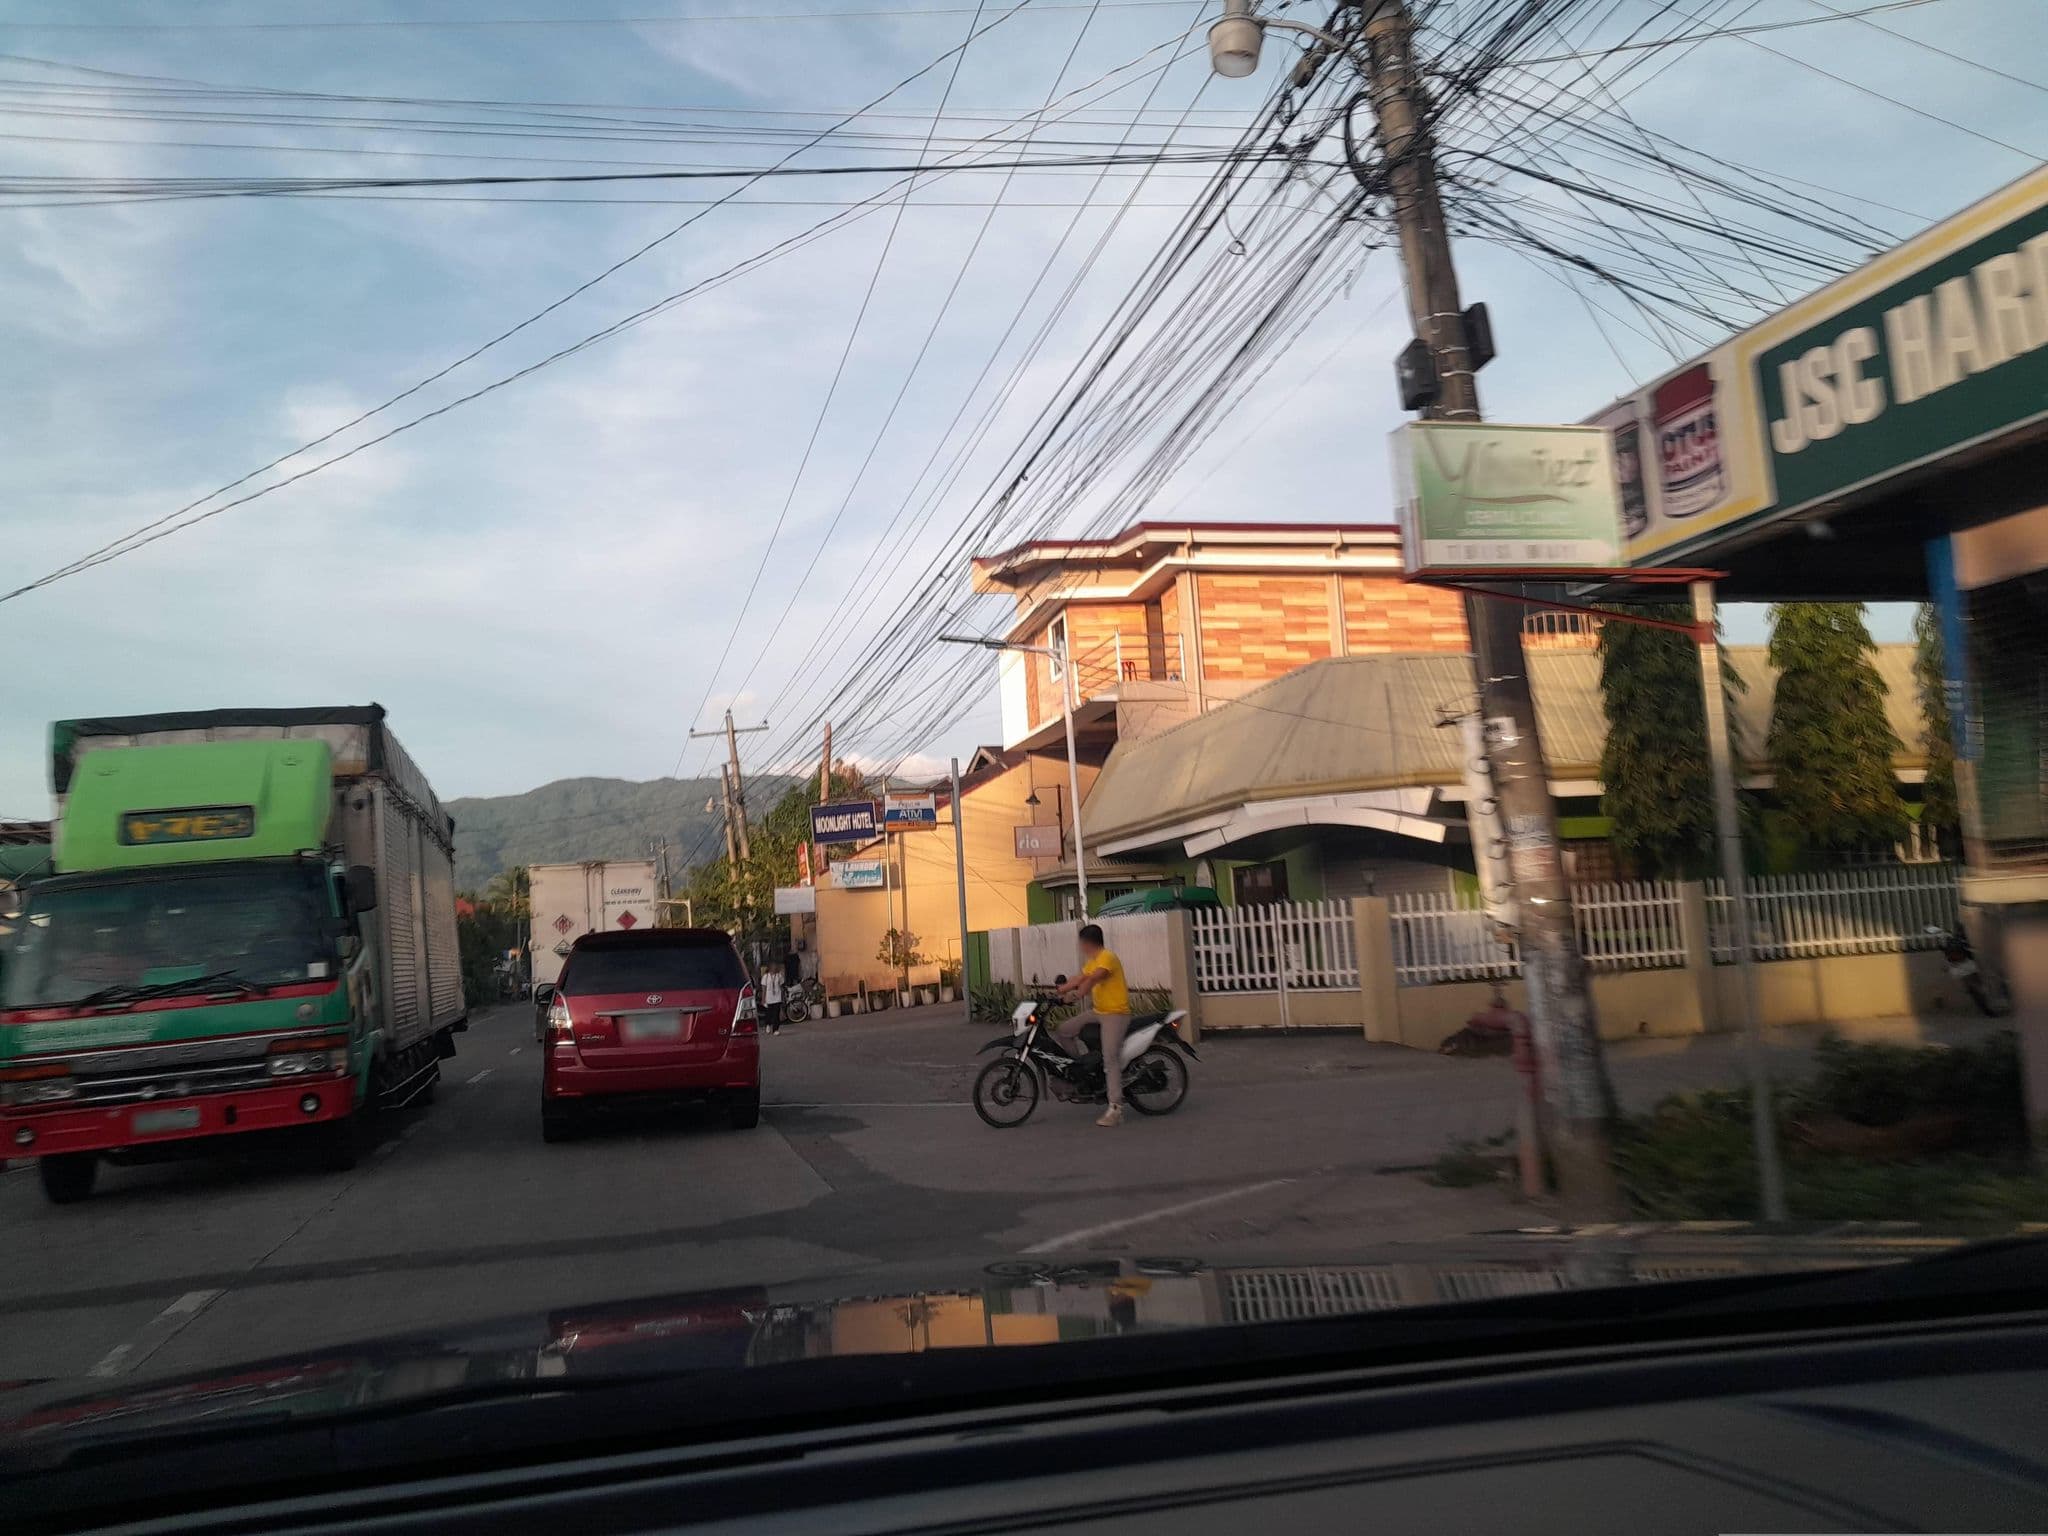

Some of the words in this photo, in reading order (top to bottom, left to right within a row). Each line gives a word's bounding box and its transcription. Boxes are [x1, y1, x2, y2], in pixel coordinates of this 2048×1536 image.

[1771, 326, 1887, 454] JSC
[815, 813, 852, 834] MOONLIGHT
[852, 811, 874, 831] HOTEL
[899, 809, 923, 821] ATM
[1019, 833, 1040, 849] ria
